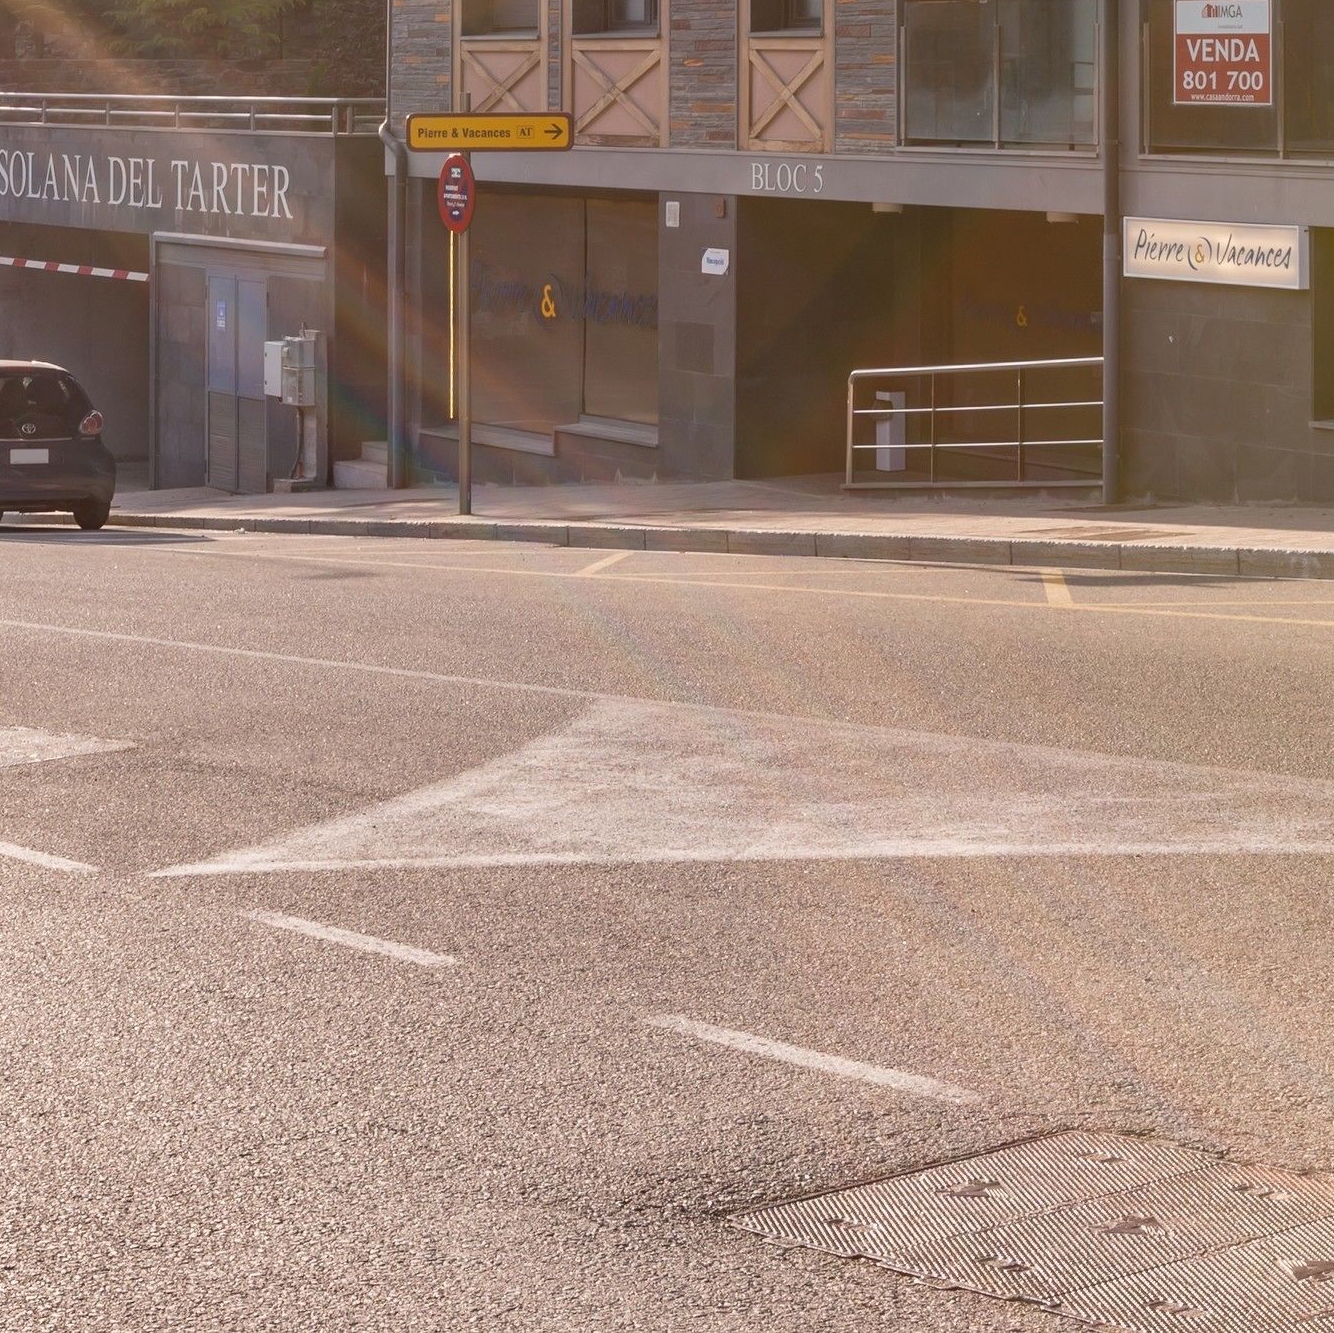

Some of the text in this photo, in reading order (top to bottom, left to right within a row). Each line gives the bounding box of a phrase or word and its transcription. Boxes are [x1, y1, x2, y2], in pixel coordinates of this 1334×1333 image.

[1186, 38, 1260, 62] VENDA
[1183, 70, 1264, 90] 801 700
[1190, 93, 1255, 102] www.casaandorra.com
[418, 127, 533, 139] Pierre & Vacances AT
[107, 156, 163, 208] DEL
[171, 159, 294, 219] TARTER
[751, 162, 823, 193] BLOC 5
[1134, 228, 1292, 269] Pierre & Vacances
